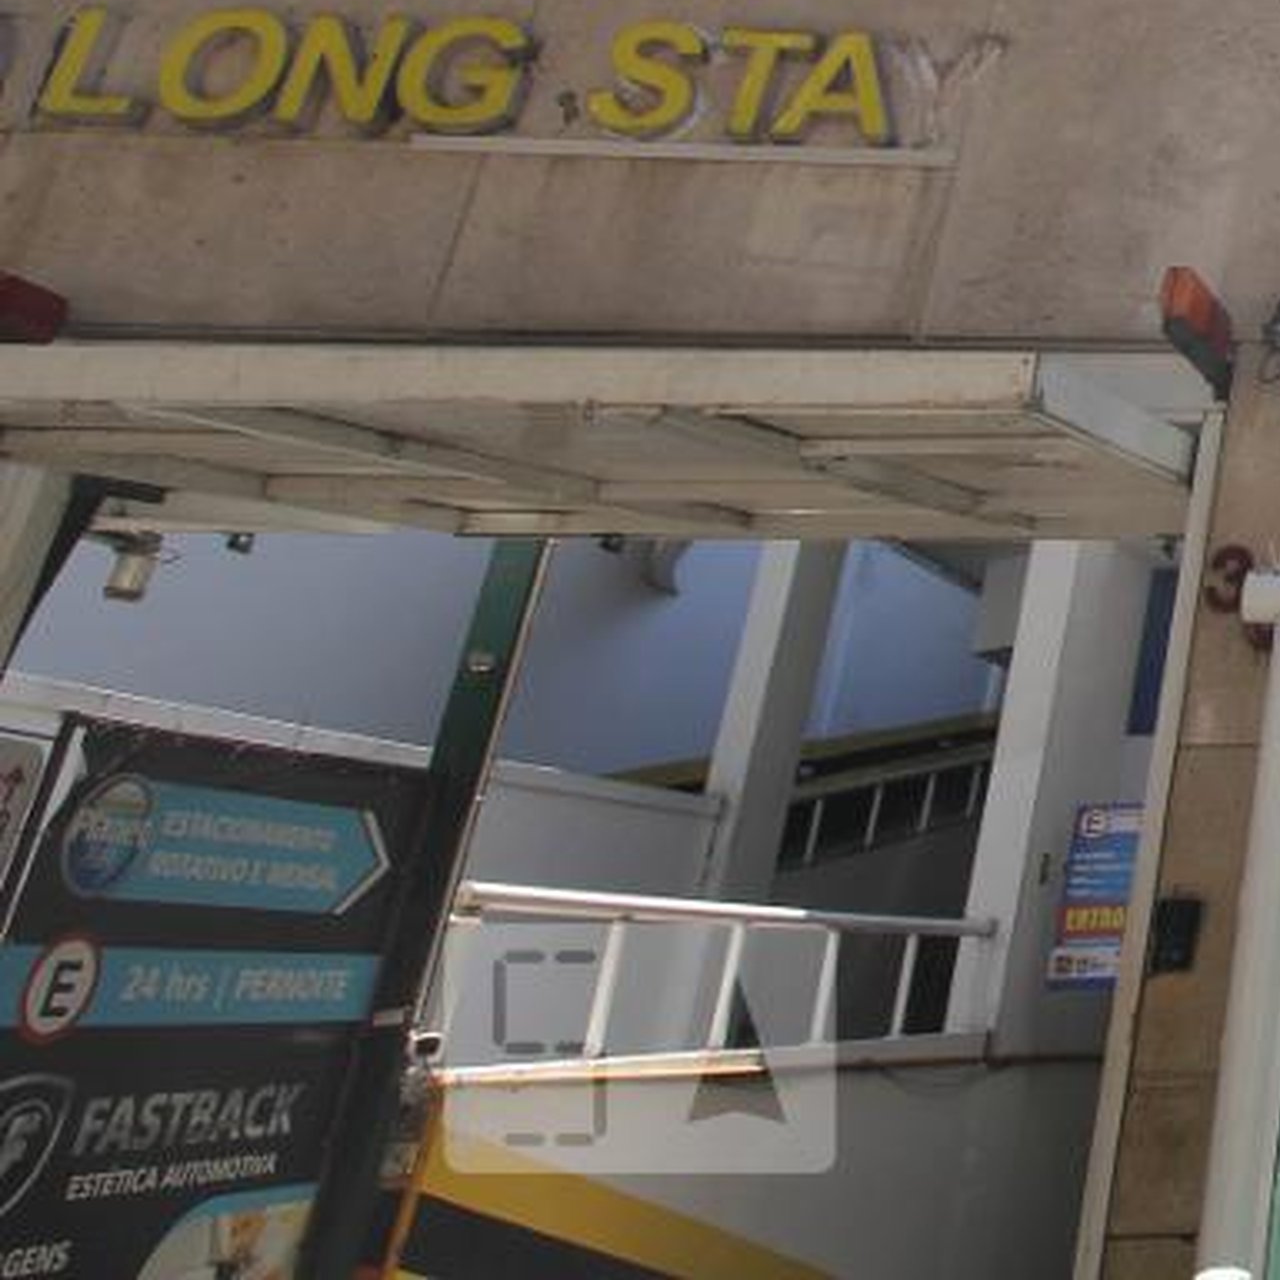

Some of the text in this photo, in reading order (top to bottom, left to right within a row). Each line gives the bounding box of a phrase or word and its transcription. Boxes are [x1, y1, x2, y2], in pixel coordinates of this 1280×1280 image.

[40, 5, 528, 131] LONG
[39, 959, 83, 1017] E
[120, 966, 157, 1001] 24
[234, 970, 349, 1001] PERNOITE
[72, 1083, 307, 1155] FASTBACK
[0, 1239, 72, 1278] GENS
